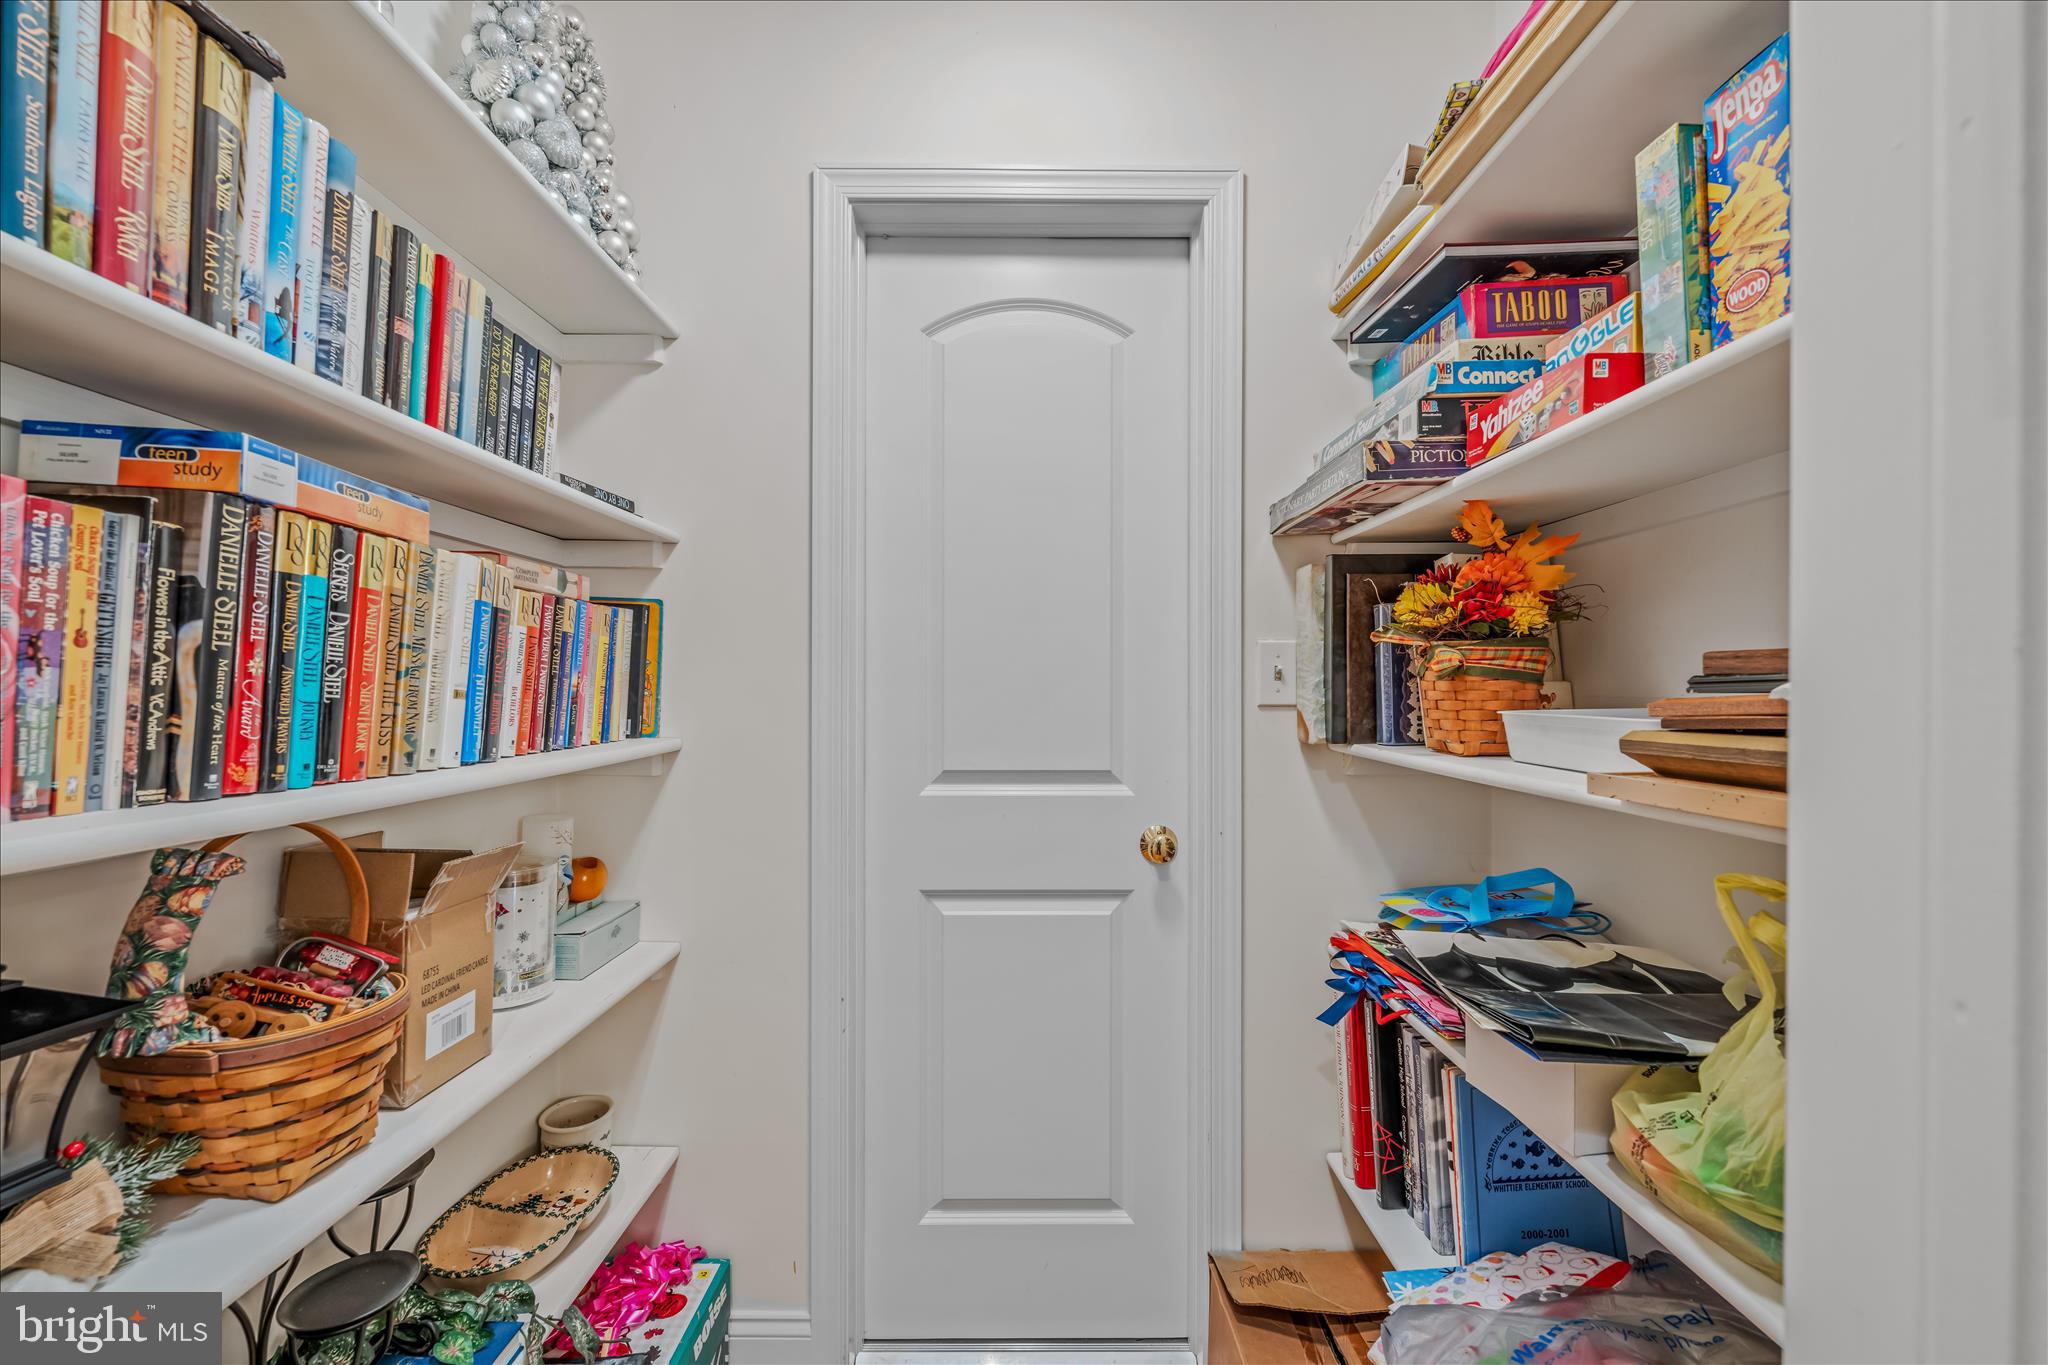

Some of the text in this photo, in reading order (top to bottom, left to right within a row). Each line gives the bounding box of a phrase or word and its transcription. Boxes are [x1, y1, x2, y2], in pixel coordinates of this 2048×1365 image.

[15, 12, 49, 85] STEEL
[121, 58, 154, 137] DANIELLE
[171, 17, 192, 175] DANIELLE STEEL
[1711, 62, 1786, 161] Jenga
[24, 94, 45, 171] Southern
[282, 105, 302, 176] DANIELLE
[16, 177, 44, 230] Lights
[165, 179, 180, 244] COMPASS
[215, 173, 235, 212] STEEL
[280, 175, 298, 216] STEEL
[311, 128, 328, 249] DANIELLE STEEL
[114, 206, 148, 262] RANCH
[331, 191, 352, 256] DANIELLE
[1640, 218, 1653, 252] 500
[203, 227, 224, 294] IMAGE
[222, 229, 236, 312] MIRROR
[404, 241, 419, 320] DANIELLE STEEL
[1492, 288, 1568, 324] TABOO
[1729, 277, 1766, 306] WOOD
[328, 339, 341, 372] Waters
[488, 325, 502, 417] DO YOU REMEMBER?
[499, 335, 512, 422] THE EX FREIDA
[540, 356, 551, 376] THE
[1402, 328, 1436, 378] TABOO
[1436, 362, 1452, 375] MB
[1457, 367, 1536, 386] Connect
[1594, 360, 1607, 371] MB
[511, 352, 525, 409] LOCKED DOOR
[524, 365, 536, 410] TEACHER
[538, 375, 550, 403] WIFE
[1422, 400, 1439, 412] MB
[535, 402, 549, 450] UPSTAIRS
[1481, 381, 1544, 445] Yahtzee
[148, 444, 188, 460] teen
[173, 461, 223, 481] study
[356, 502, 384, 522] study
[24, 510, 49, 603] Pet Lover's Soul
[43, 512, 66, 632] Chicken Soup for the
[155, 567, 176, 616] Flowers
[463, 582, 477, 633] DANIELLE
[94, 592, 117, 668] GETTYSBURG
[152, 629, 173, 651] the
[154, 616, 171, 629] in
[210, 504, 246, 766] DANIELLE STEEL Matters of the Heart
[239, 530, 274, 741] DANIELLE STEEL Award
[323, 548, 355, 703] SECRETS DANIELLE STEEL
[404, 550, 434, 736] DANIELLE STEEL MESSAGE FROM NAM
[479, 605, 492, 643] DANIELLE
[550, 605, 565, 676] DANIELLE STEEL
[576, 604, 588, 668] DANIELLE STEEL
[150, 650, 172, 687] Attic
[275, 580, 303, 754] DANIELLE STEEL ANSWERED PRAYERS
[298, 595, 325, 743] DANIELLE STEEL JOURNEY
[353, 593, 382, 753] DANIELLE STEEL SILENT HONOR
[378, 592, 405, 747] DANIELLE STEEL THE KISS
[477, 640, 489, 669] STEEL
[494, 612, 511, 685] DANIELLE STEEL
[536, 604, 555, 716] FAMILY ALBUM DANIELLE STEEL
[508, 686, 519, 727] BACHELORS
[251, 985, 296, 1006] APPLES
[421, 954, 489, 996] LED CARDINAL FRIEND CANDLE
[421, 983, 460, 1008] MADE IN CHINA
[1397, 1066, 1405, 1083] High
[1485, 1135, 1503, 1170] WORKING
[1493, 1179, 1590, 1193] WHITTIER ELEMENTARY SCHOOL
[1520, 1228, 1570, 1240] 2000-2001
[1663, 1304, 1716, 1330] Pay
